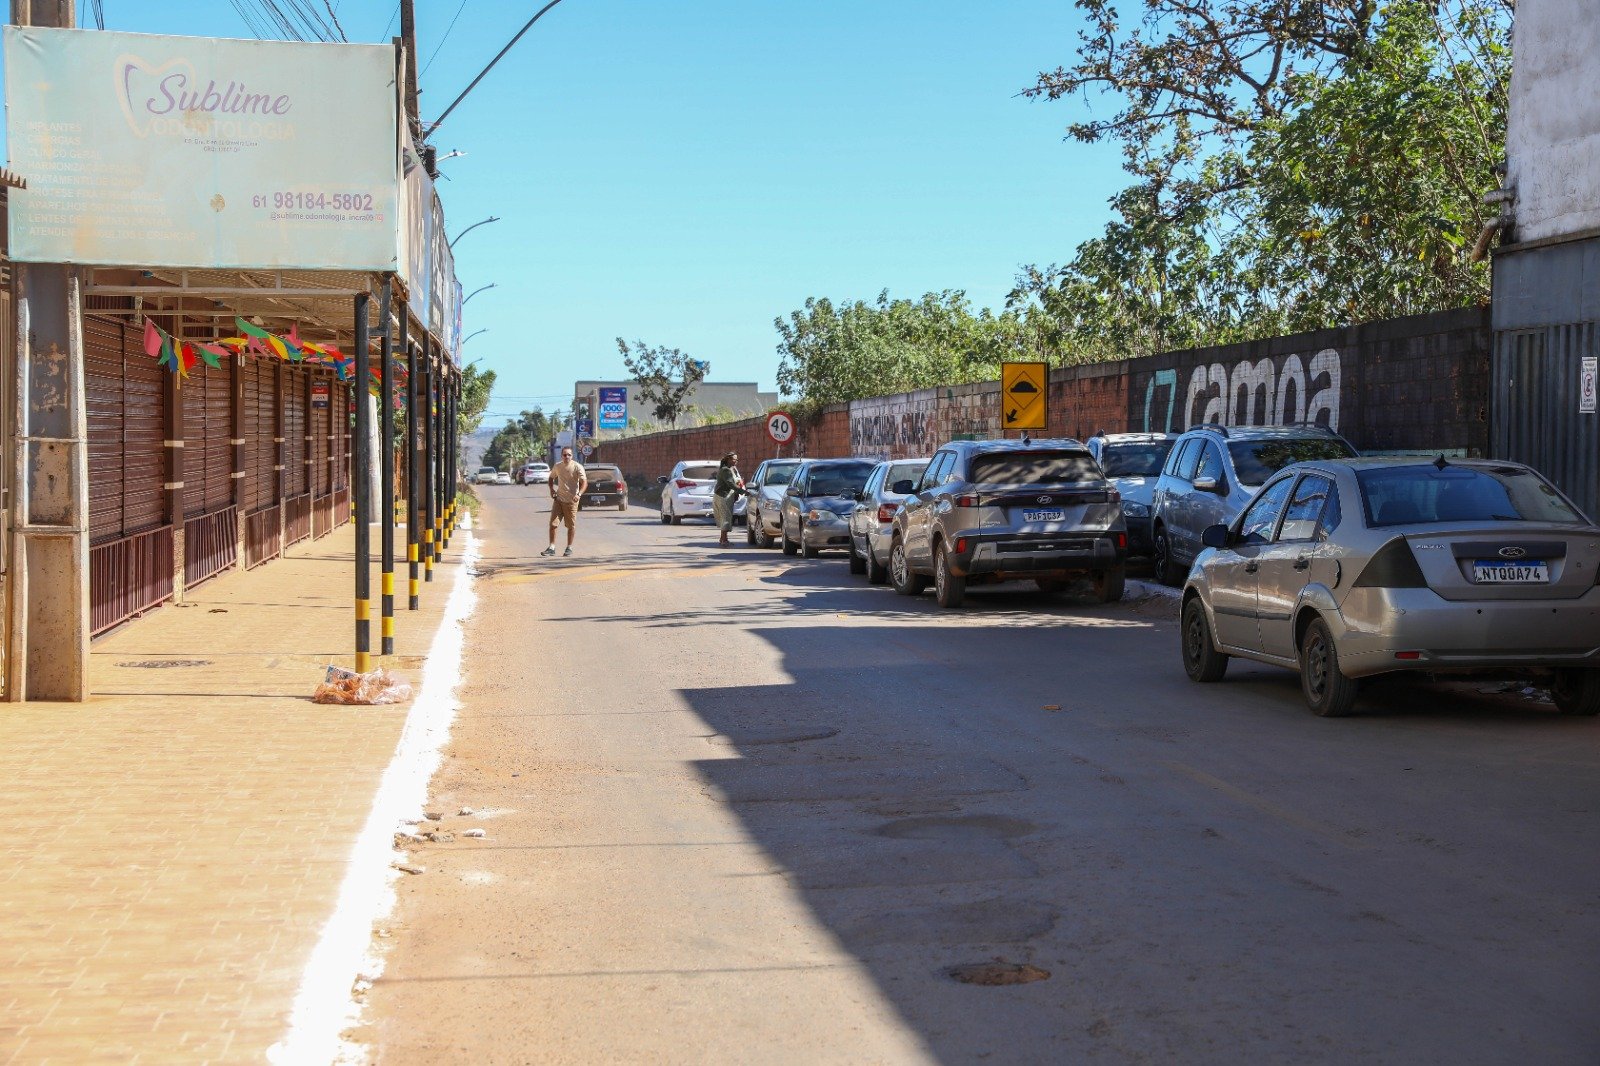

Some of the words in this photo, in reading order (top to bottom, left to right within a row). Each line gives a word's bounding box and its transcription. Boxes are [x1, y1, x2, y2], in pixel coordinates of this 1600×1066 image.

[146, 73, 292, 115] Sublime
[152, 118, 295, 139] ODONTOLOGIA
[252, 194, 268, 208] 61
[273, 191, 374, 211] 98184-5802
[771, 418, 789, 433] 40
